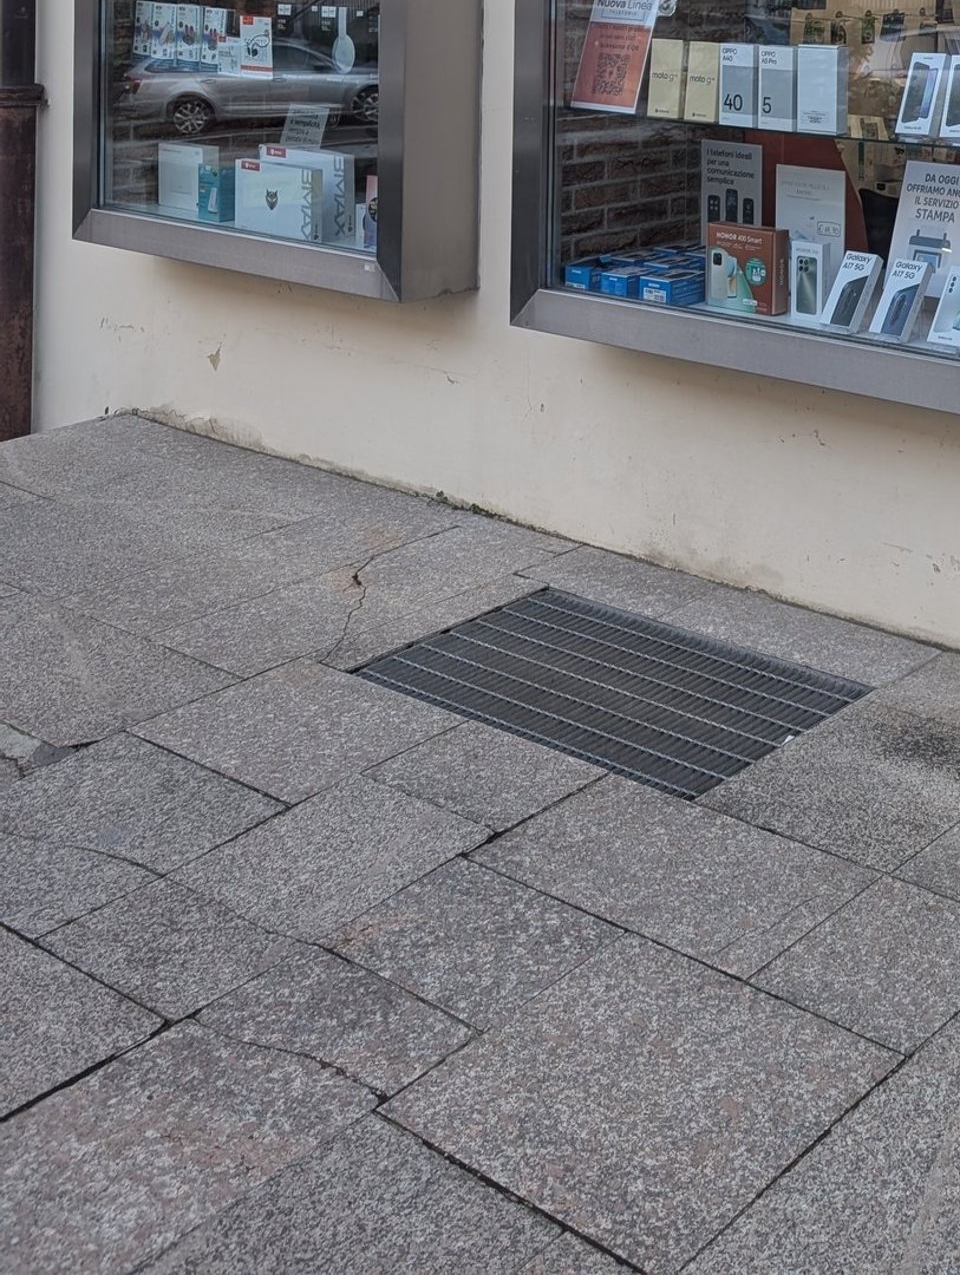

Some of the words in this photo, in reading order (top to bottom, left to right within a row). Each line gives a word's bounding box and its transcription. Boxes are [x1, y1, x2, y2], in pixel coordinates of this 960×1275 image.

[722, 47, 737, 55] OPPO
[722, 55, 733, 63] A40
[652, 72, 668, 80] moto
[689, 75, 705, 83] moto
[723, 94, 743, 111] 40
[762, 96, 772, 114] 5
[710, 149, 733, 158] telefoni
[706, 159, 717, 167] per
[706, 168, 754, 179] comunicazione
[925, 173, 937, 183] DA
[938, 174, 960, 185] OGGI
[706, 175, 734, 185] semplice
[906, 183, 945, 196] OFFRIAMO
[334, 155, 345, 236] BMAX
[914, 196, 922, 205] IL
[922, 197, 960, 210] SERVIZIO
[915, 208, 955, 224] STAMPA
[717, 232, 737, 240] HONOR
[747, 236, 762, 244] Smart
[846, 253, 872, 265] Galaxy
[842, 262, 854, 271] A17
[854, 263, 865, 272] 5G
[895, 260, 922, 273] Galaxy
[891, 270, 904, 279] A17
[904, 271, 915, 280] 5G
